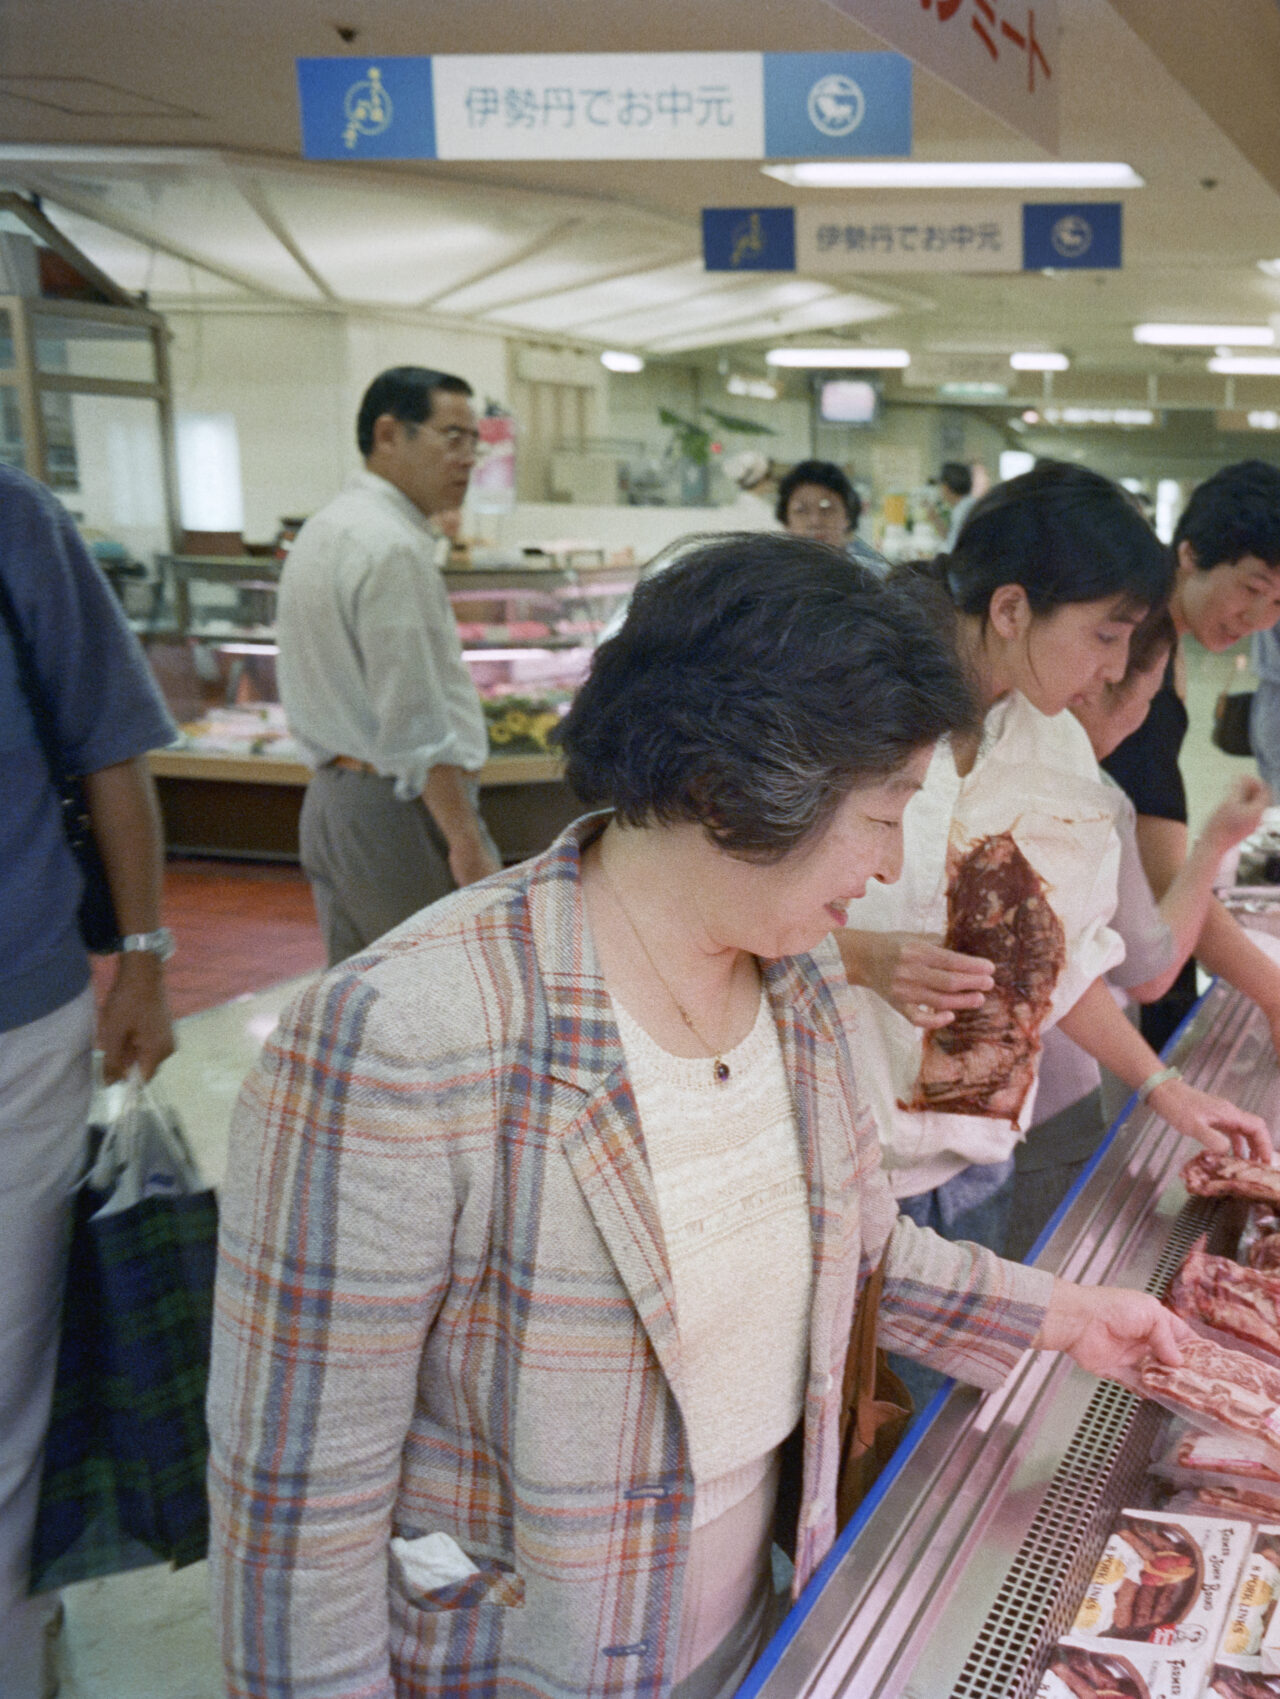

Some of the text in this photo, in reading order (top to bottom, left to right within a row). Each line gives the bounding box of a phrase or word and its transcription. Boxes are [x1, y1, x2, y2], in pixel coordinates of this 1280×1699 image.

[465, 83, 734, 128] 伊勢丹でお中元
[816, 222, 1001, 254] 伊勢丹でお中元
